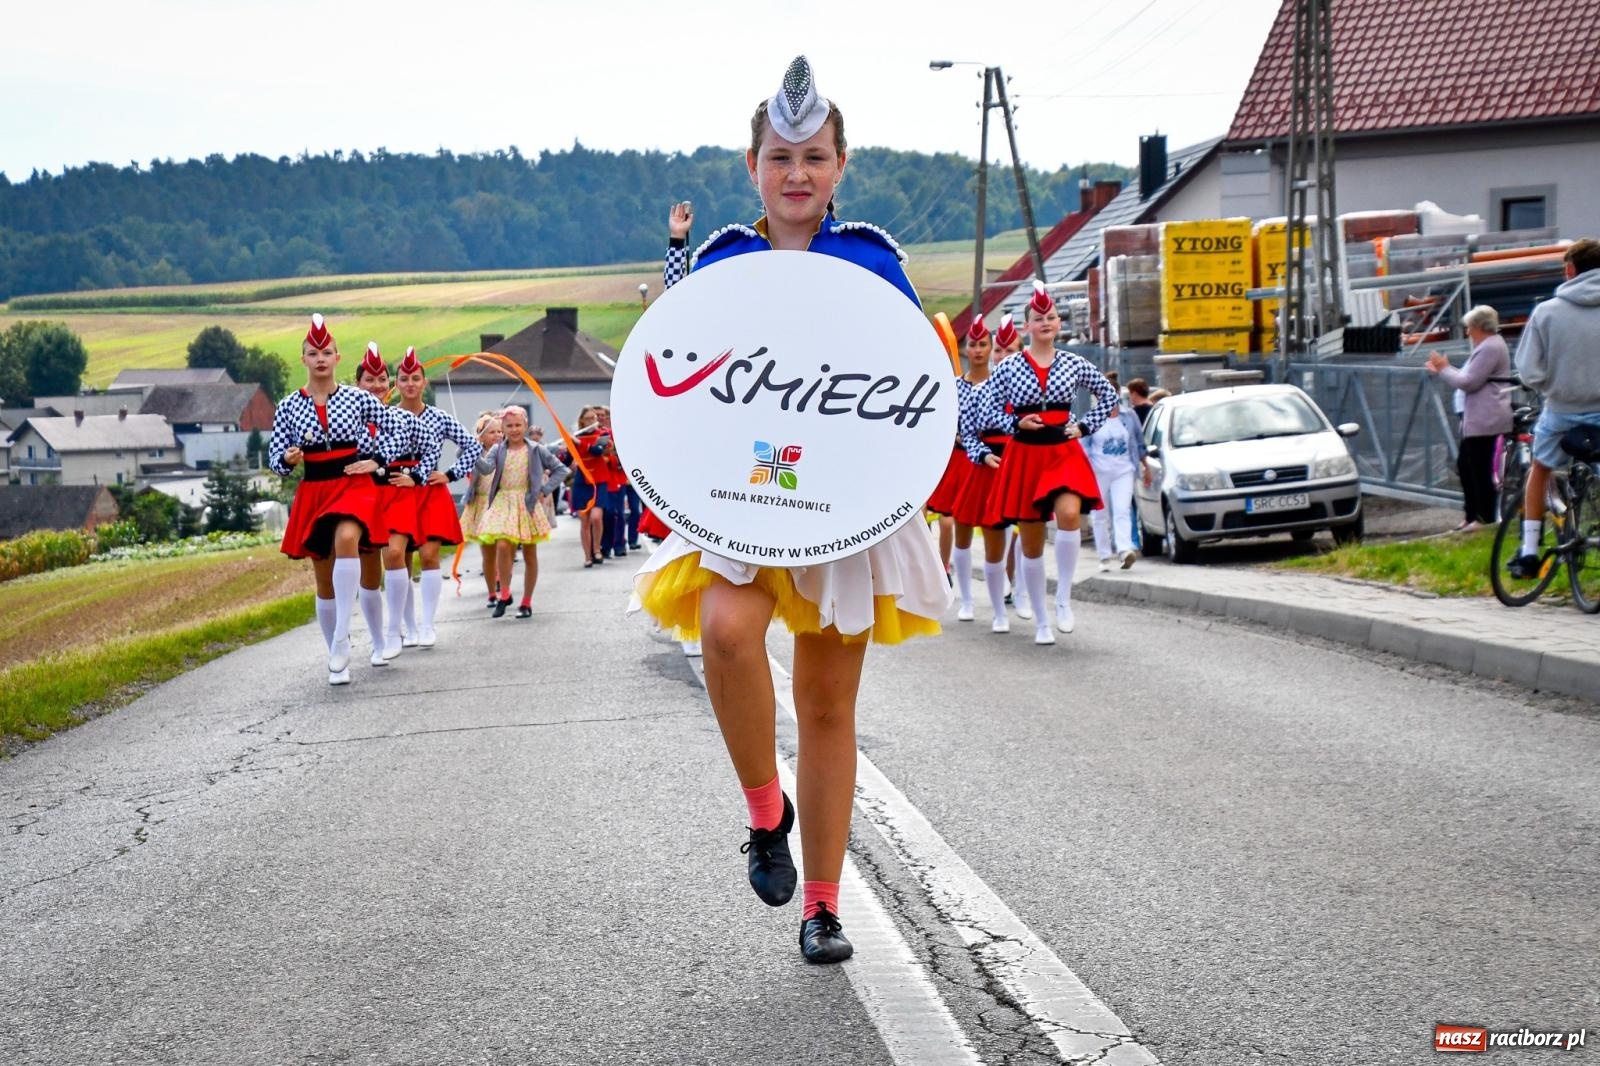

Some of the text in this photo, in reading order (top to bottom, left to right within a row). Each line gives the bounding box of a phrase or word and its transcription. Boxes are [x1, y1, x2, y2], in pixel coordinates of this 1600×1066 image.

[1172, 235, 1243, 251] YTONG
[1172, 282, 1244, 298] YTONG
[710, 489, 831, 512] GMINA KRZYŻANOWICE
[631, 468, 914, 558] GMINNY OŚRODEK KULTURY W KRZYŻANOWICACH
